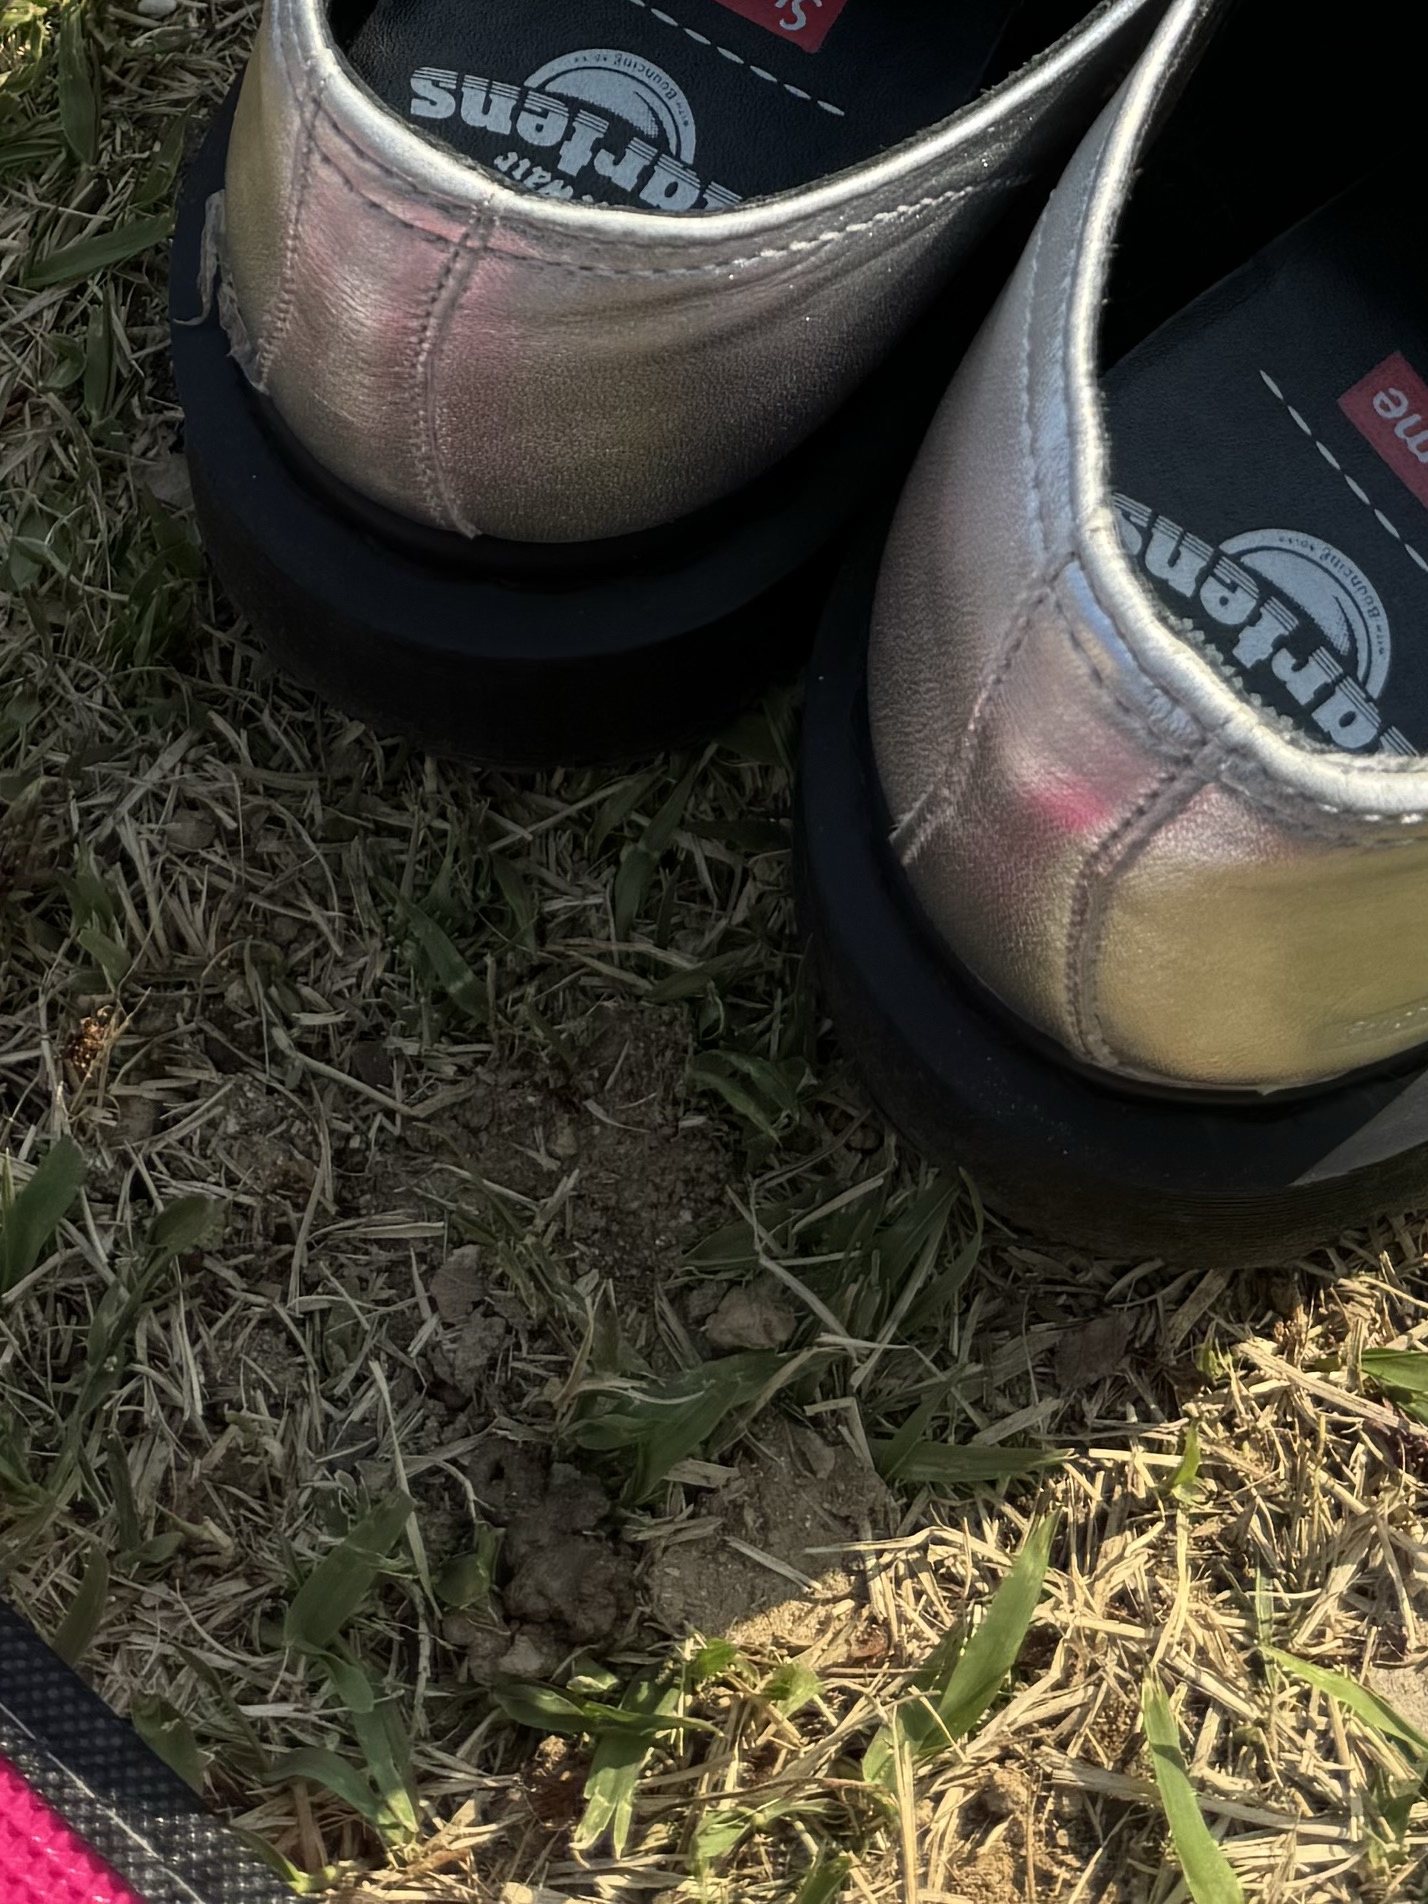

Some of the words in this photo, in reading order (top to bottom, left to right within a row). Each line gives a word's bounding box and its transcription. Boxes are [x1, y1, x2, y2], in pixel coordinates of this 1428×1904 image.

[612, 53, 678, 100] Bouncing
[1318, 543, 1381, 618] Bouncing
[1110, 491, 1420, 756] artens
